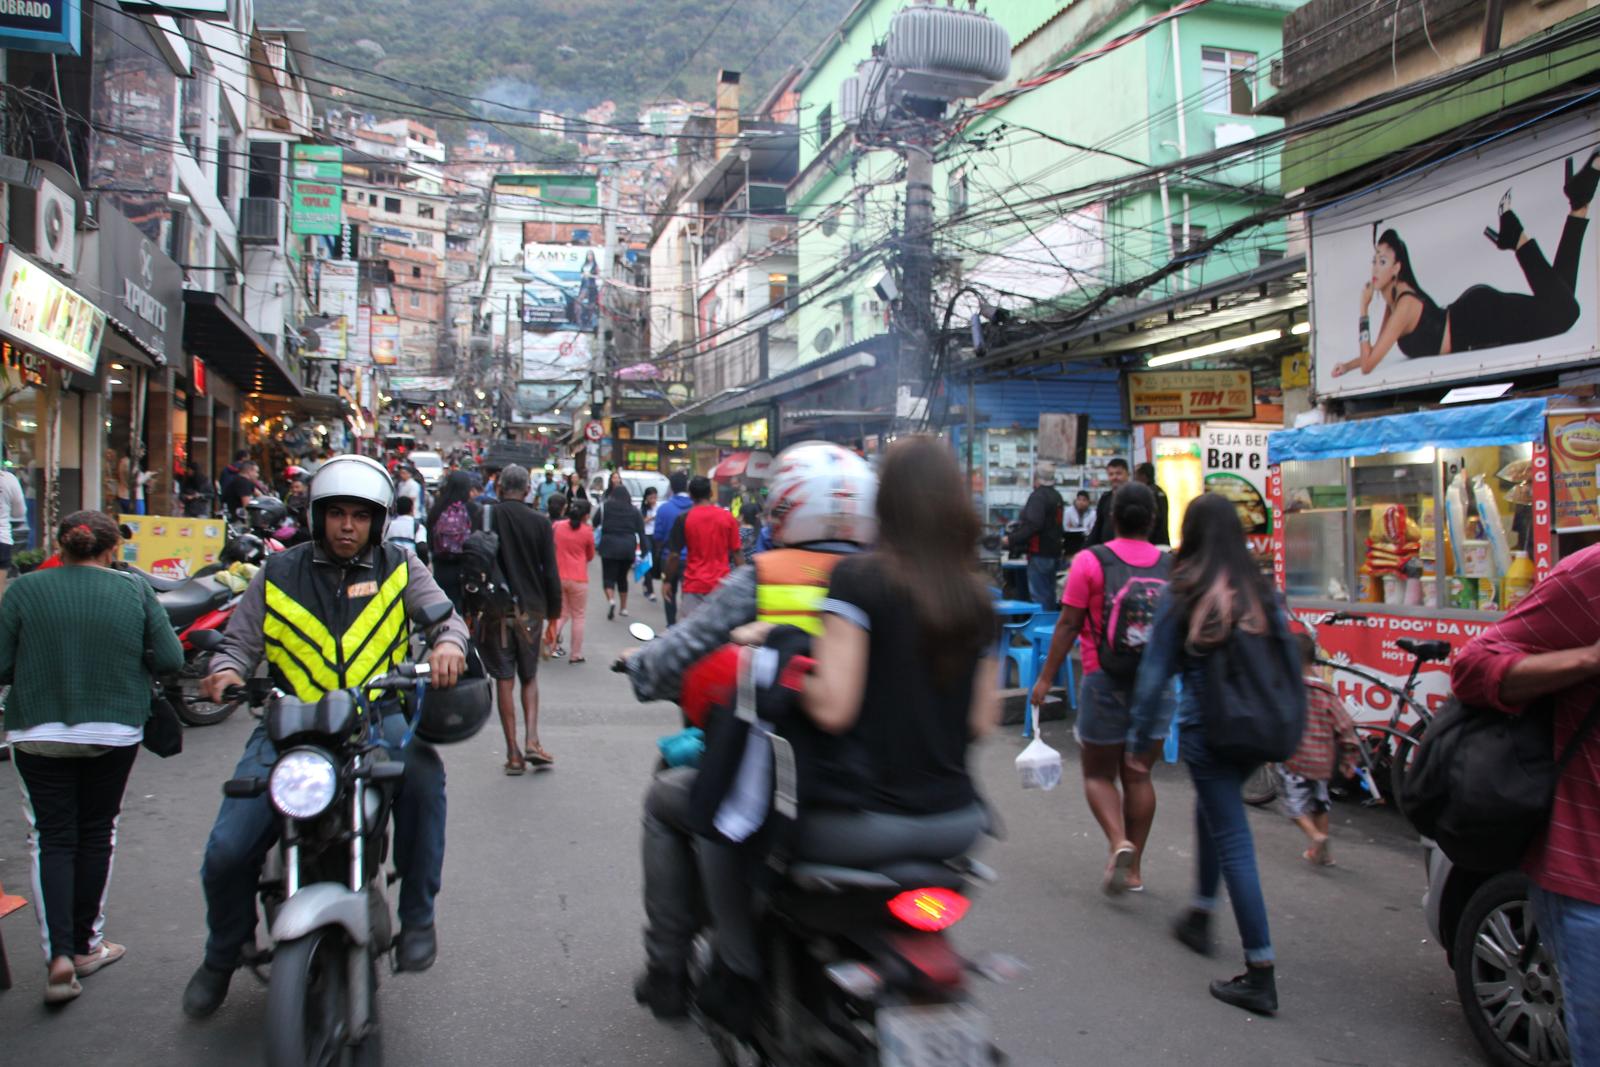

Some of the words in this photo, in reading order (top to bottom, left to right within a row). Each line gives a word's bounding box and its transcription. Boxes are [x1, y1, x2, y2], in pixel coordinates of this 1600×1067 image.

[1208, 433, 1242, 446] SEJA
[1207, 448, 1244, 469] Bar
[1535, 500, 1548, 525] DU
[1436, 620, 1461, 635] DA
